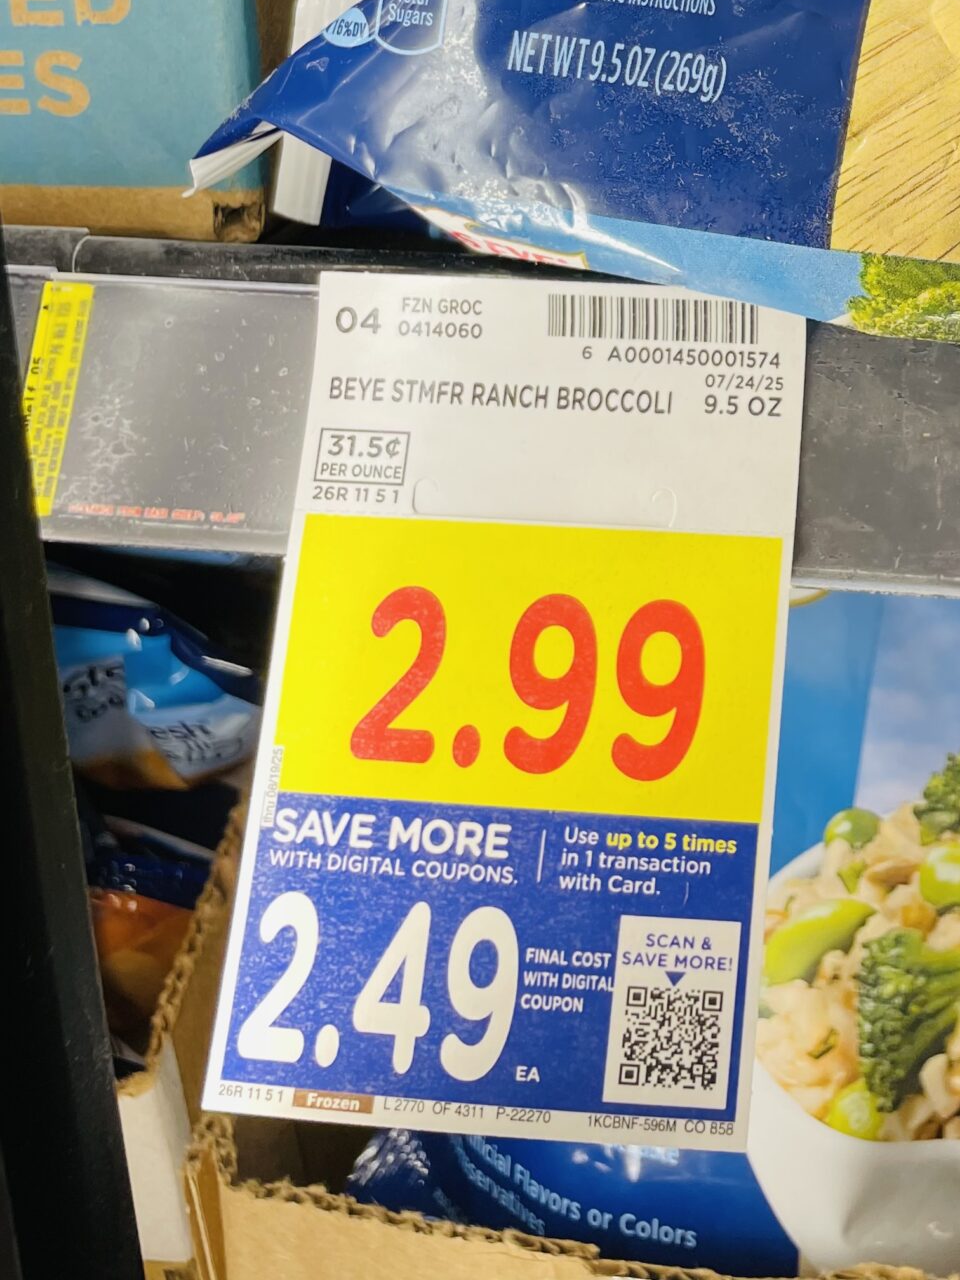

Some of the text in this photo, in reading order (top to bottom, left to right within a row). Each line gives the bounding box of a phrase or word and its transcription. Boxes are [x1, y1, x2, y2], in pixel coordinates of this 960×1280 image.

[387, 2, 434, 27] Sugars
[507, 30, 727, 103] NET WT 9.5 OZ (269g)
[402, 297, 483, 316] FZN GROC
[336, 306, 382, 335] 04
[398, 321, 483, 339] 0414060
[582, 345, 593, 360] 6
[705, 374, 784, 392] 07/24/25
[329, 376, 783, 417] BEYE STMFR RANCH BROCCOLI 9.5 OZ
[327, 434, 401, 459] 31.5¢
[320, 462, 402, 480] PER OUNCE
[312, 485, 348, 502] 26R
[350, 585, 706, 782] 2.99
[272, 808, 513, 860] SAVE MORE
[564, 826, 737, 854] Use up to 5 times
[269, 849, 518, 887] WITH DIGITAL COUPONS.
[561, 848, 711, 875] in 1 transaction
[559, 873, 661, 895] with Card.
[646, 933, 713, 950] SCAN &
[525, 947, 612, 969] FINAL COST
[621, 952, 734, 971] SAVE MORE!
[237, 891, 520, 1083] 2.49
[523, 971, 616, 993] WITH DIGITAL
[521, 994, 584, 1012] COUPON
[515, 1066, 541, 1082] EA
[218, 1084, 243, 1098] 26R
[306, 1092, 361, 1111] Frozen
[383, 1097, 393, 1111] L
[394, 1098, 425, 1113] 2770
[432, 1100, 452, 1115] OF
[454, 1103, 485, 1120] 4311
[495, 1107, 551, 1124] P-22270
[684, 1121, 706, 1134] CO
[710, 1121, 734, 1136] 858
[513, 1163, 699, 1249] Flavors or Colors
